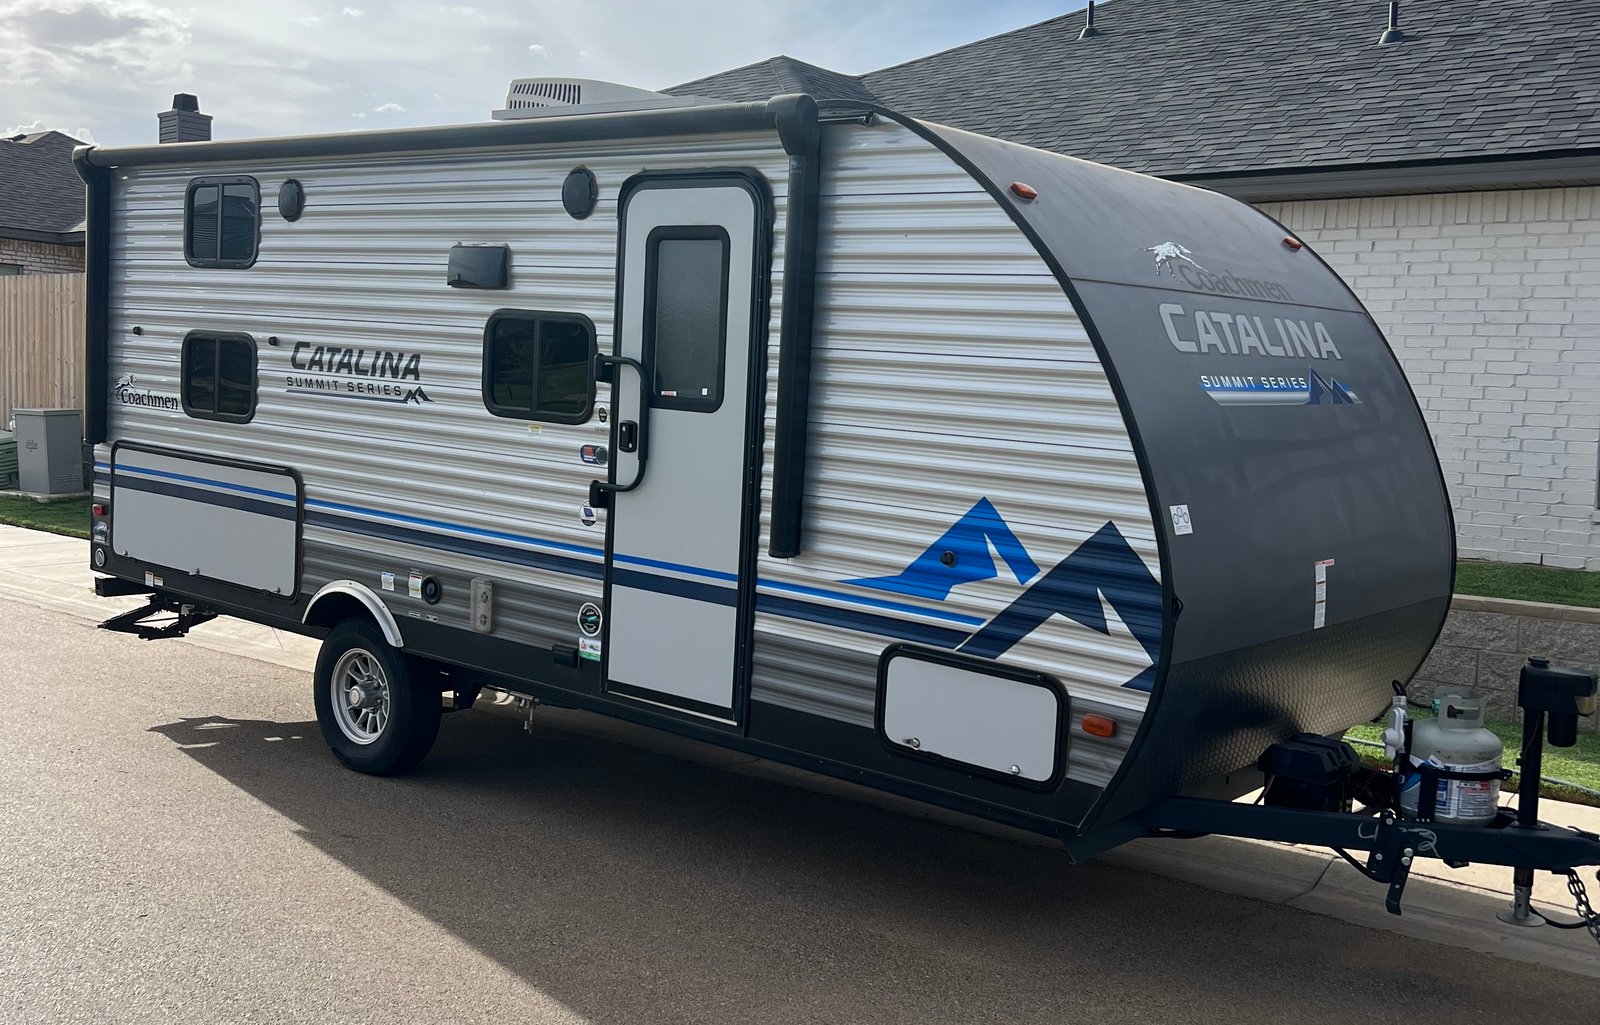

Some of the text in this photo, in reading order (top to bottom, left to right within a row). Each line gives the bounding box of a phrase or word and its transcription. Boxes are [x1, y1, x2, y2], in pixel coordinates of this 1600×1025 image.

[1177, 264, 1294, 300] Coachmen
[1159, 303, 1343, 360] CATALINA
[291, 341, 421, 380] CATALINA
[286, 377, 402, 396] SUMMIT SERIES
[1201, 375, 1308, 389] SUMMIT SERIES
[121, 389, 178, 409] Coachmen
